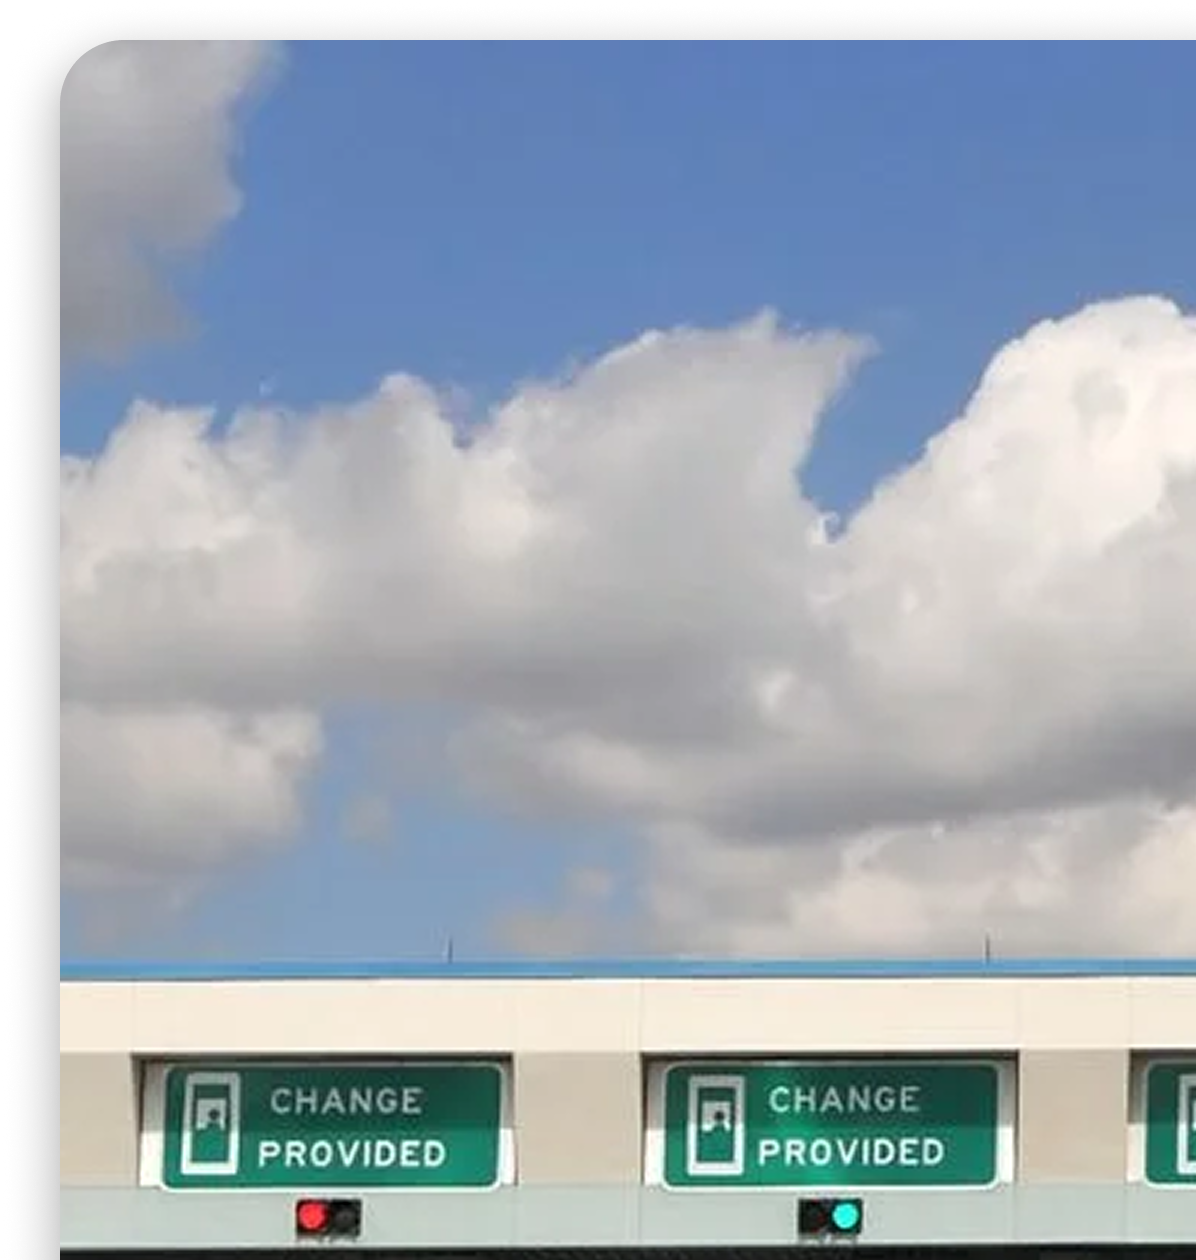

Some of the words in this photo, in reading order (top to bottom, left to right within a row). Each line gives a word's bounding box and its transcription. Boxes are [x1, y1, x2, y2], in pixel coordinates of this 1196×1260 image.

[270, 1087, 422, 1114] CHANGE
[769, 1086, 920, 1113] CHANGE
[258, 1139, 446, 1168] PROVIDED
[758, 1138, 944, 1166] PROVIDED
